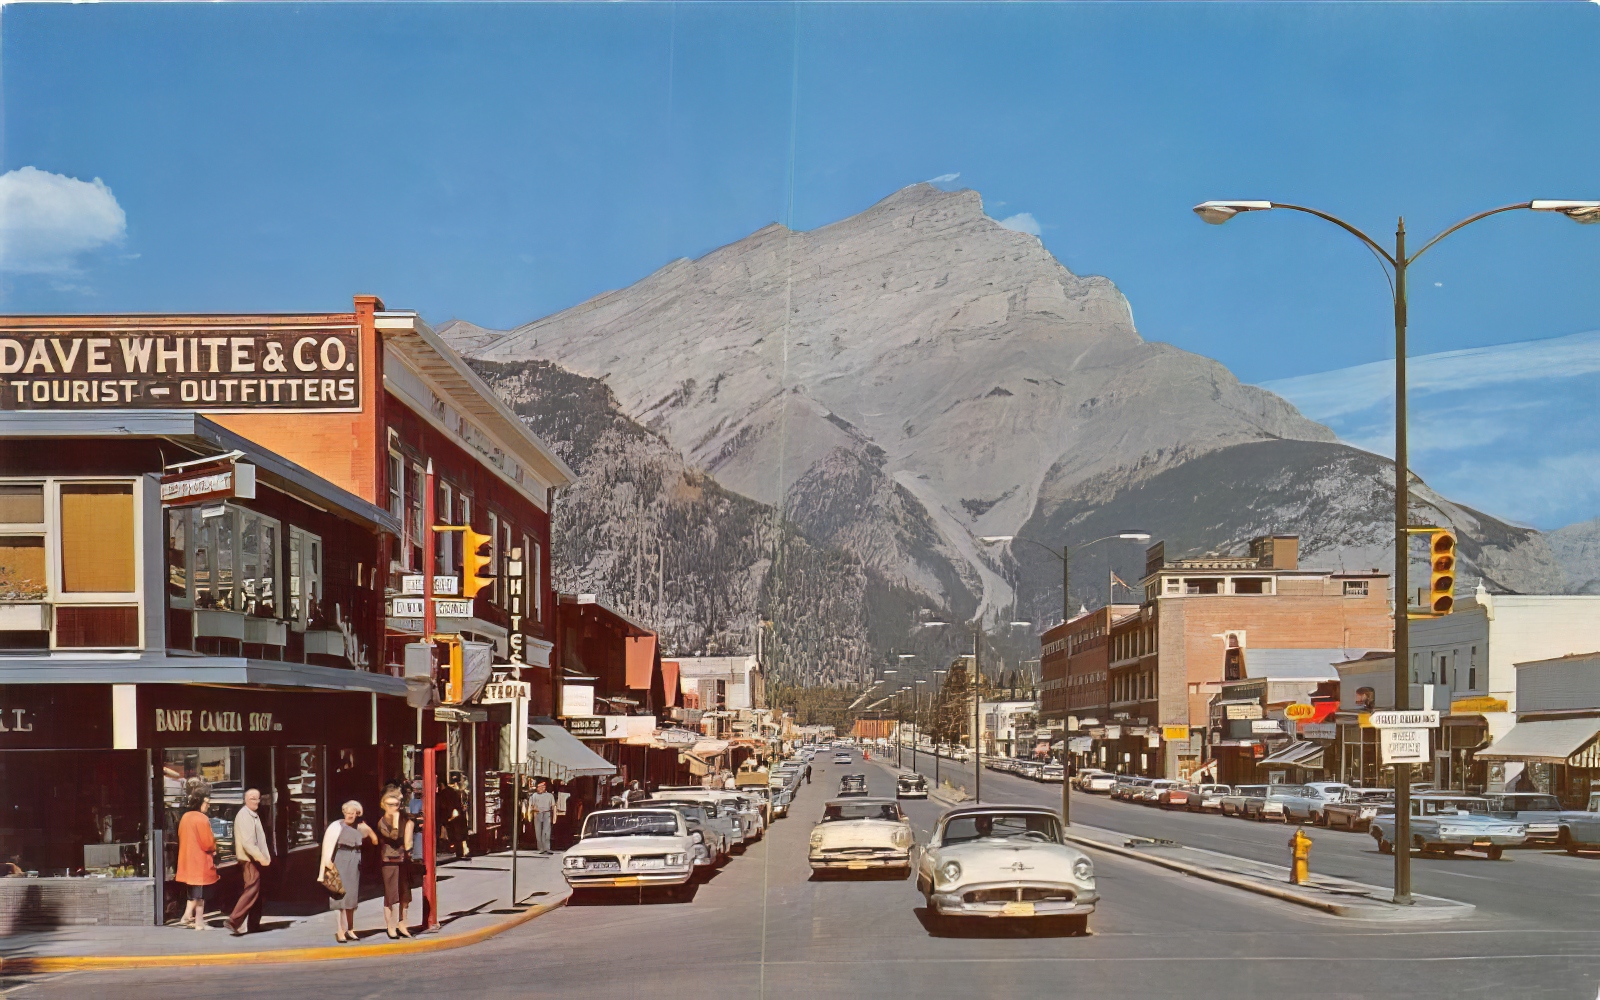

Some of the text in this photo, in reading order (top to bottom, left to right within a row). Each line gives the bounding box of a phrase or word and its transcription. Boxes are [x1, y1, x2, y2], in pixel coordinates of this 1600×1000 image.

[0, 336, 355, 374] DAVE WHITE & CO.
[10, 380, 139, 402] TOURIST
[180, 378, 355, 402] OUTFITTERS
